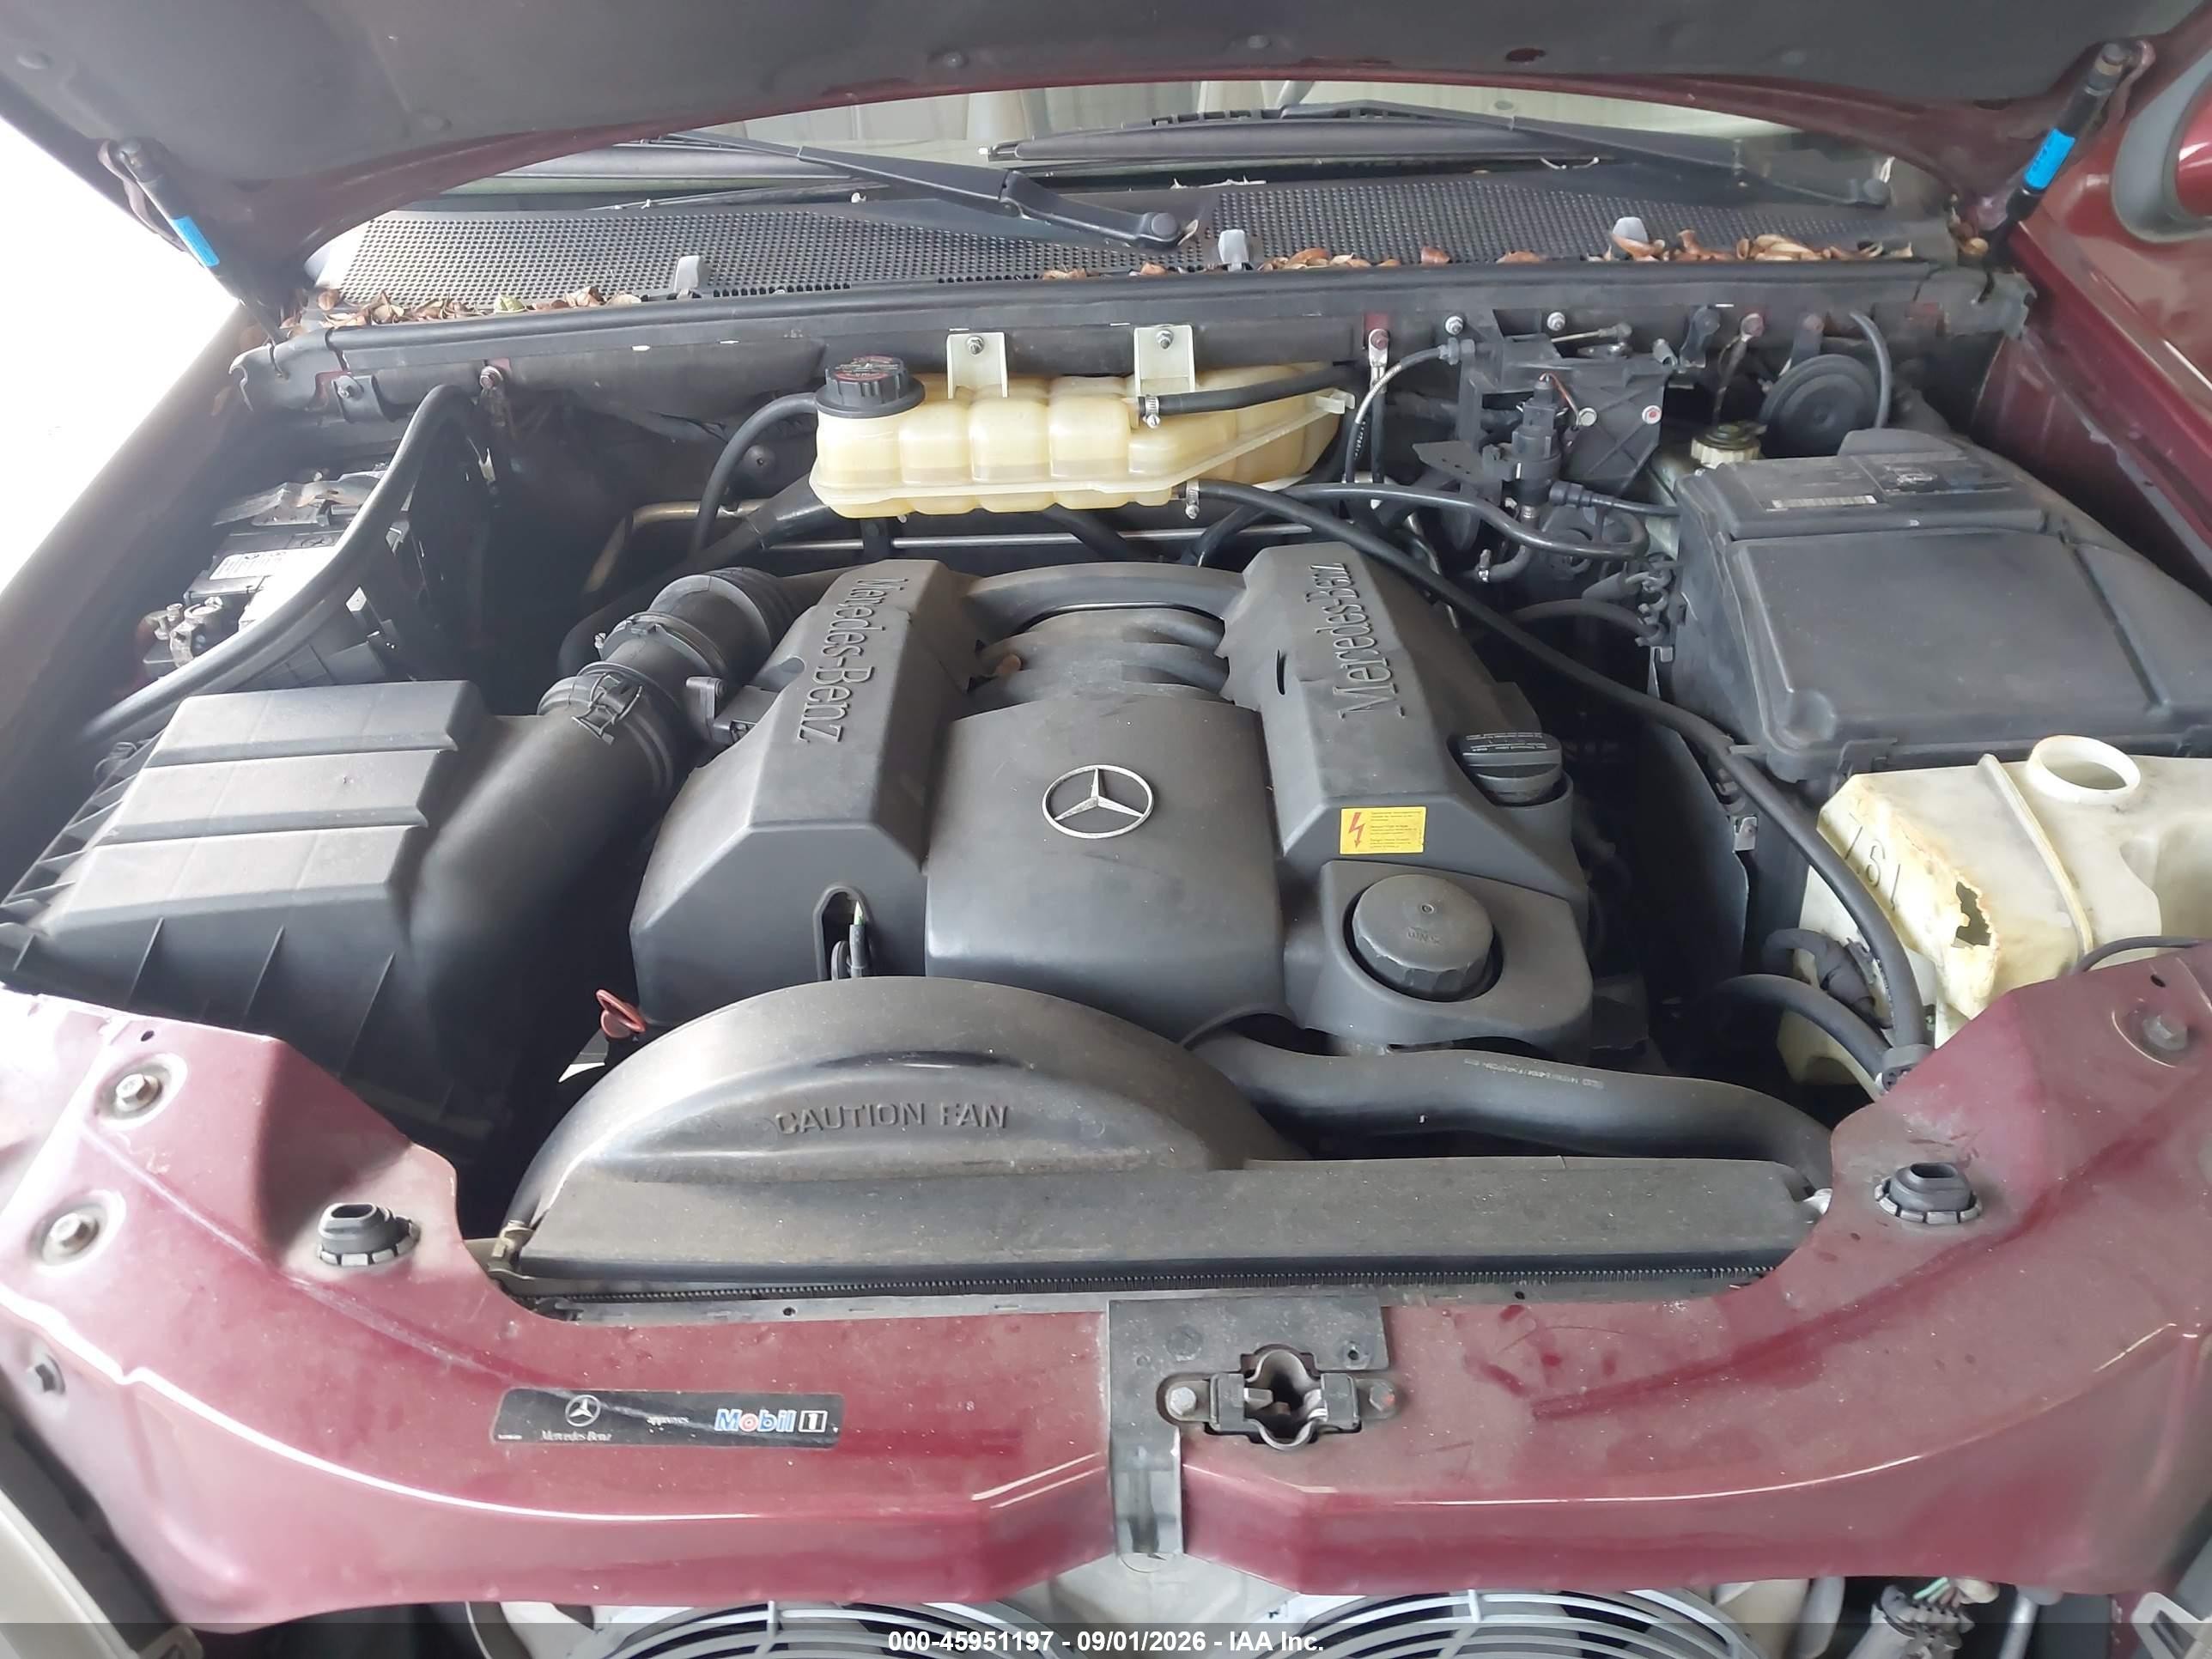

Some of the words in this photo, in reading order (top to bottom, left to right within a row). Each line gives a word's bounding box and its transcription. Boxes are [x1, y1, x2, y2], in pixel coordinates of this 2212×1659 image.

[796, 577, 909, 743] Mercedes-Benz
[1305, 562, 1407, 721] Mercedes-Benz
[775, 1103, 926, 1134] CAUTION
[939, 1102, 1008, 1129] FAN
[714, 1408, 797, 1433] Mobil
